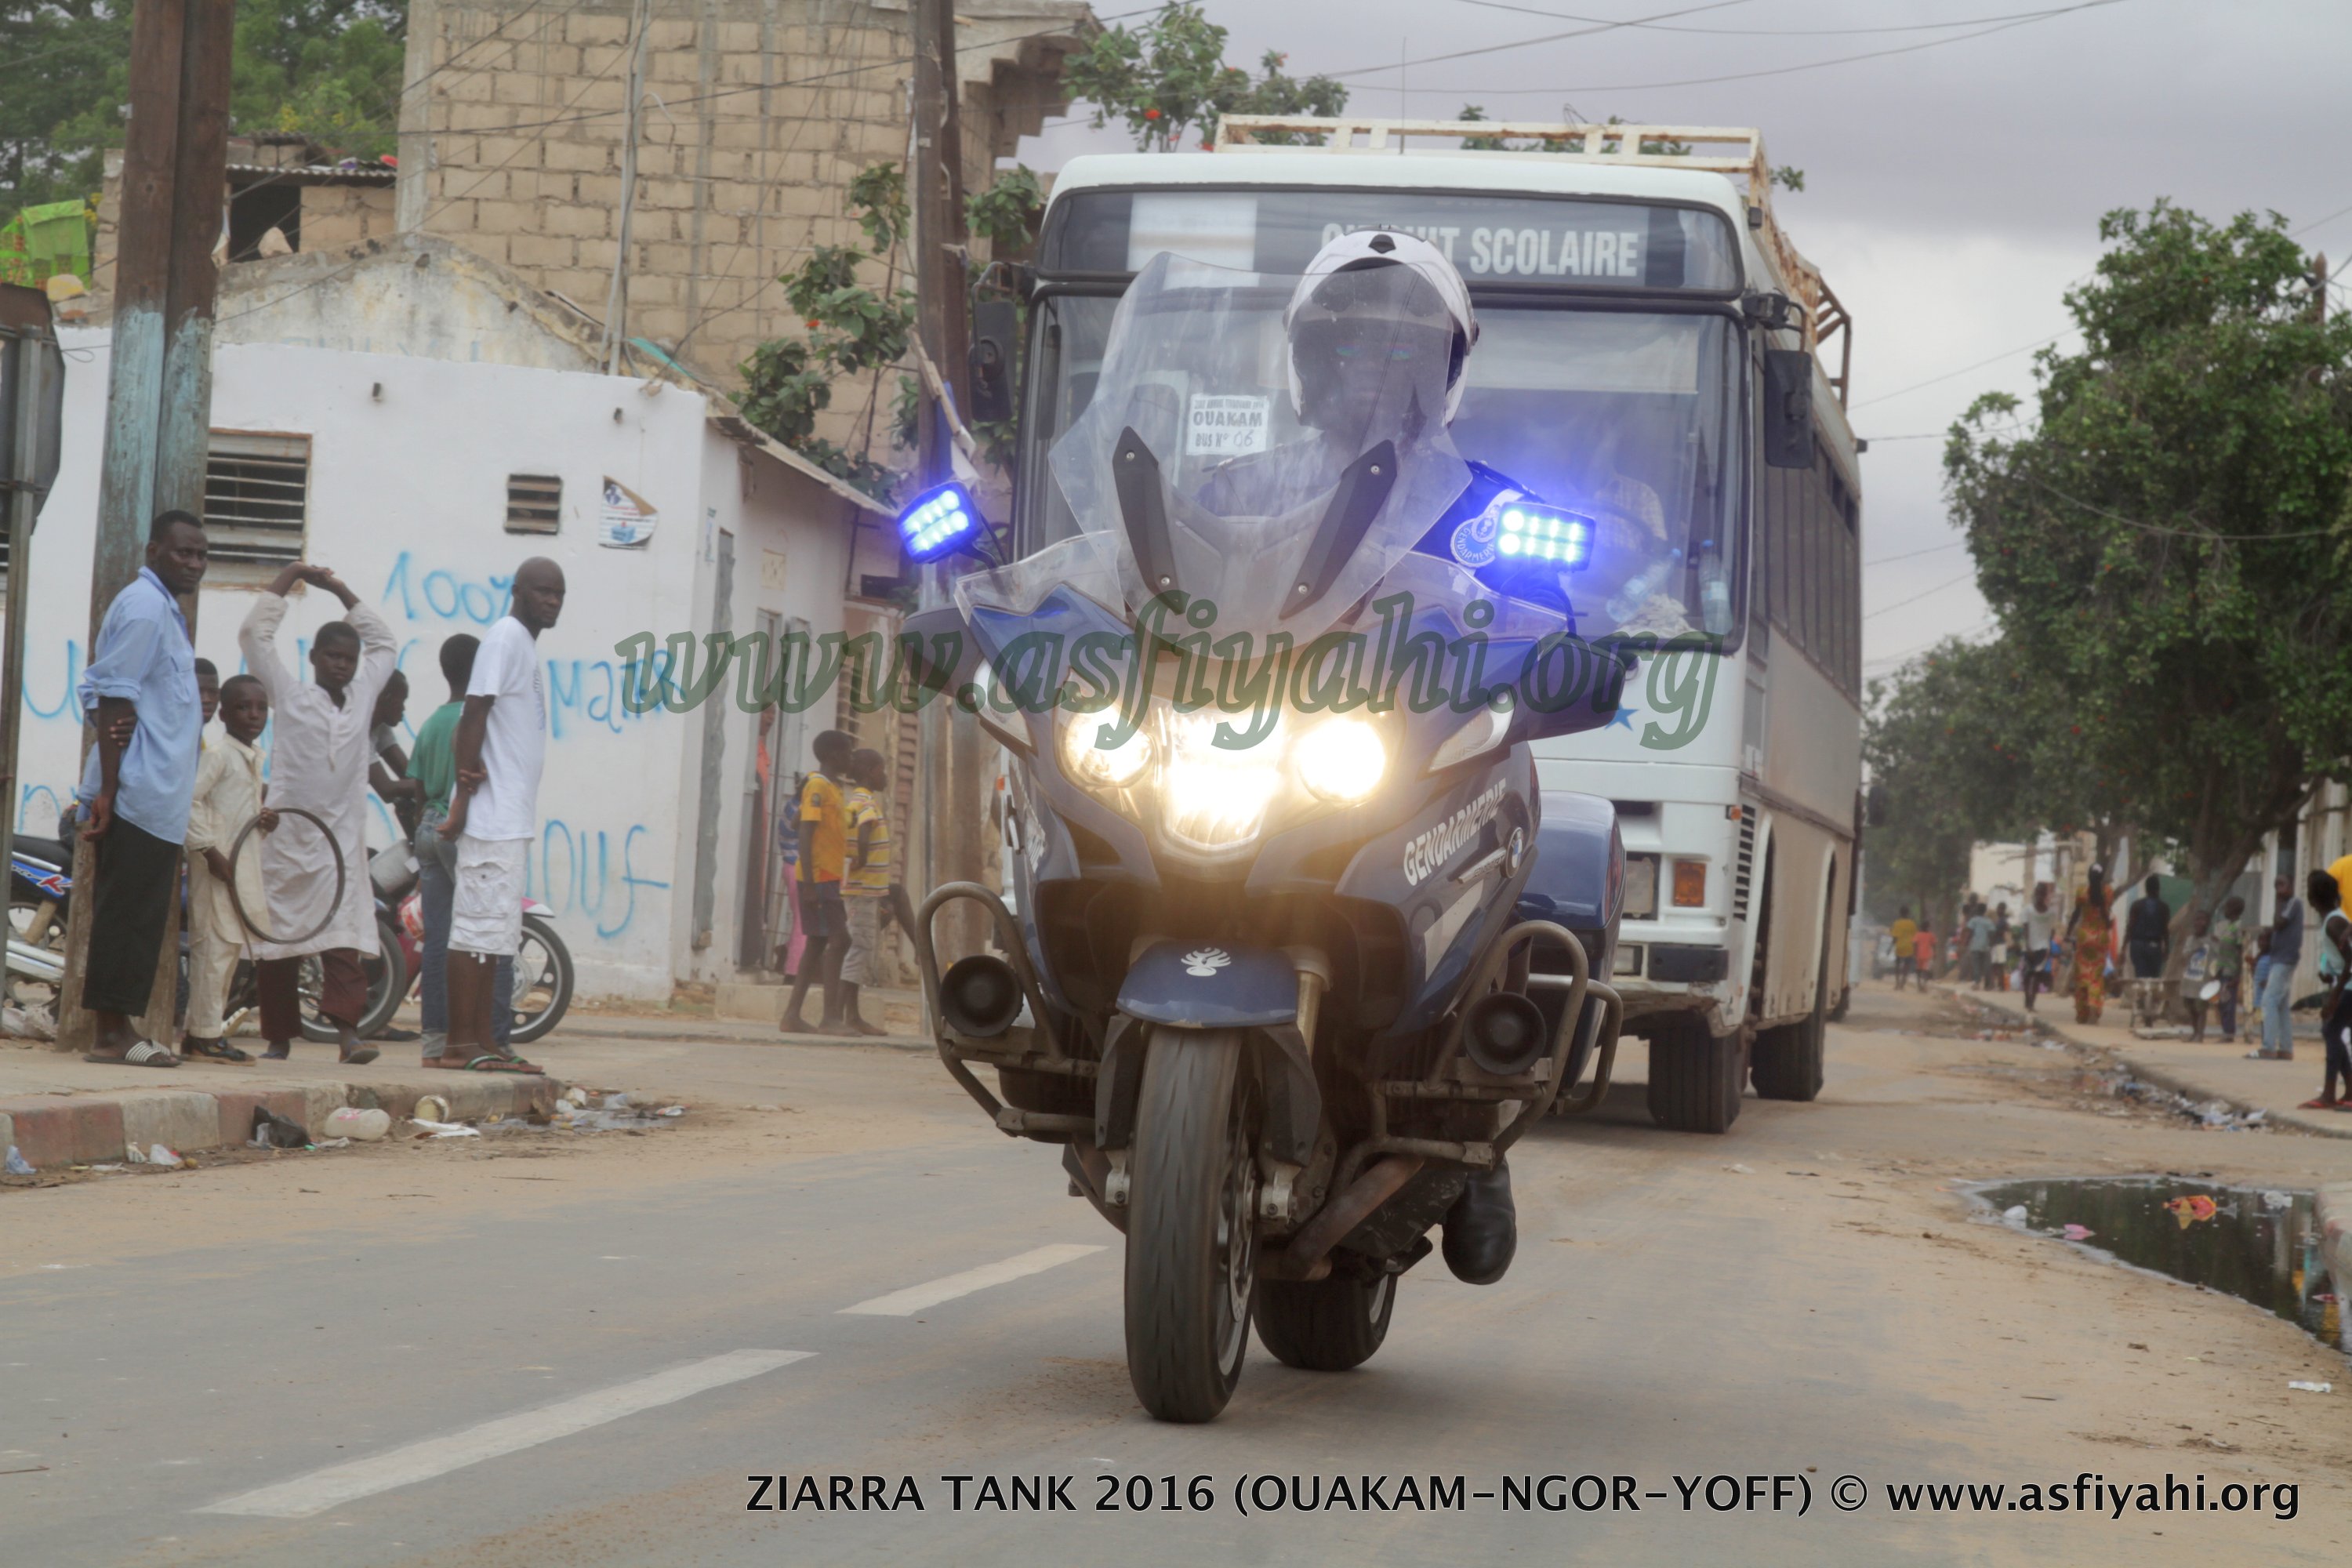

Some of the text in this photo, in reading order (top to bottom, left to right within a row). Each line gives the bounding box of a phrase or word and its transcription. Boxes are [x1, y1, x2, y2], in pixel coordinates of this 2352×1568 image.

[1469, 227, 1639, 278] SCOLAIRE
[1192, 411, 1262, 426] OUAKAM
[1195, 432, 1213, 448] BUS
[1233, 429, 1254, 447] 06
[1403, 777, 1506, 887] GENDARMERIE
